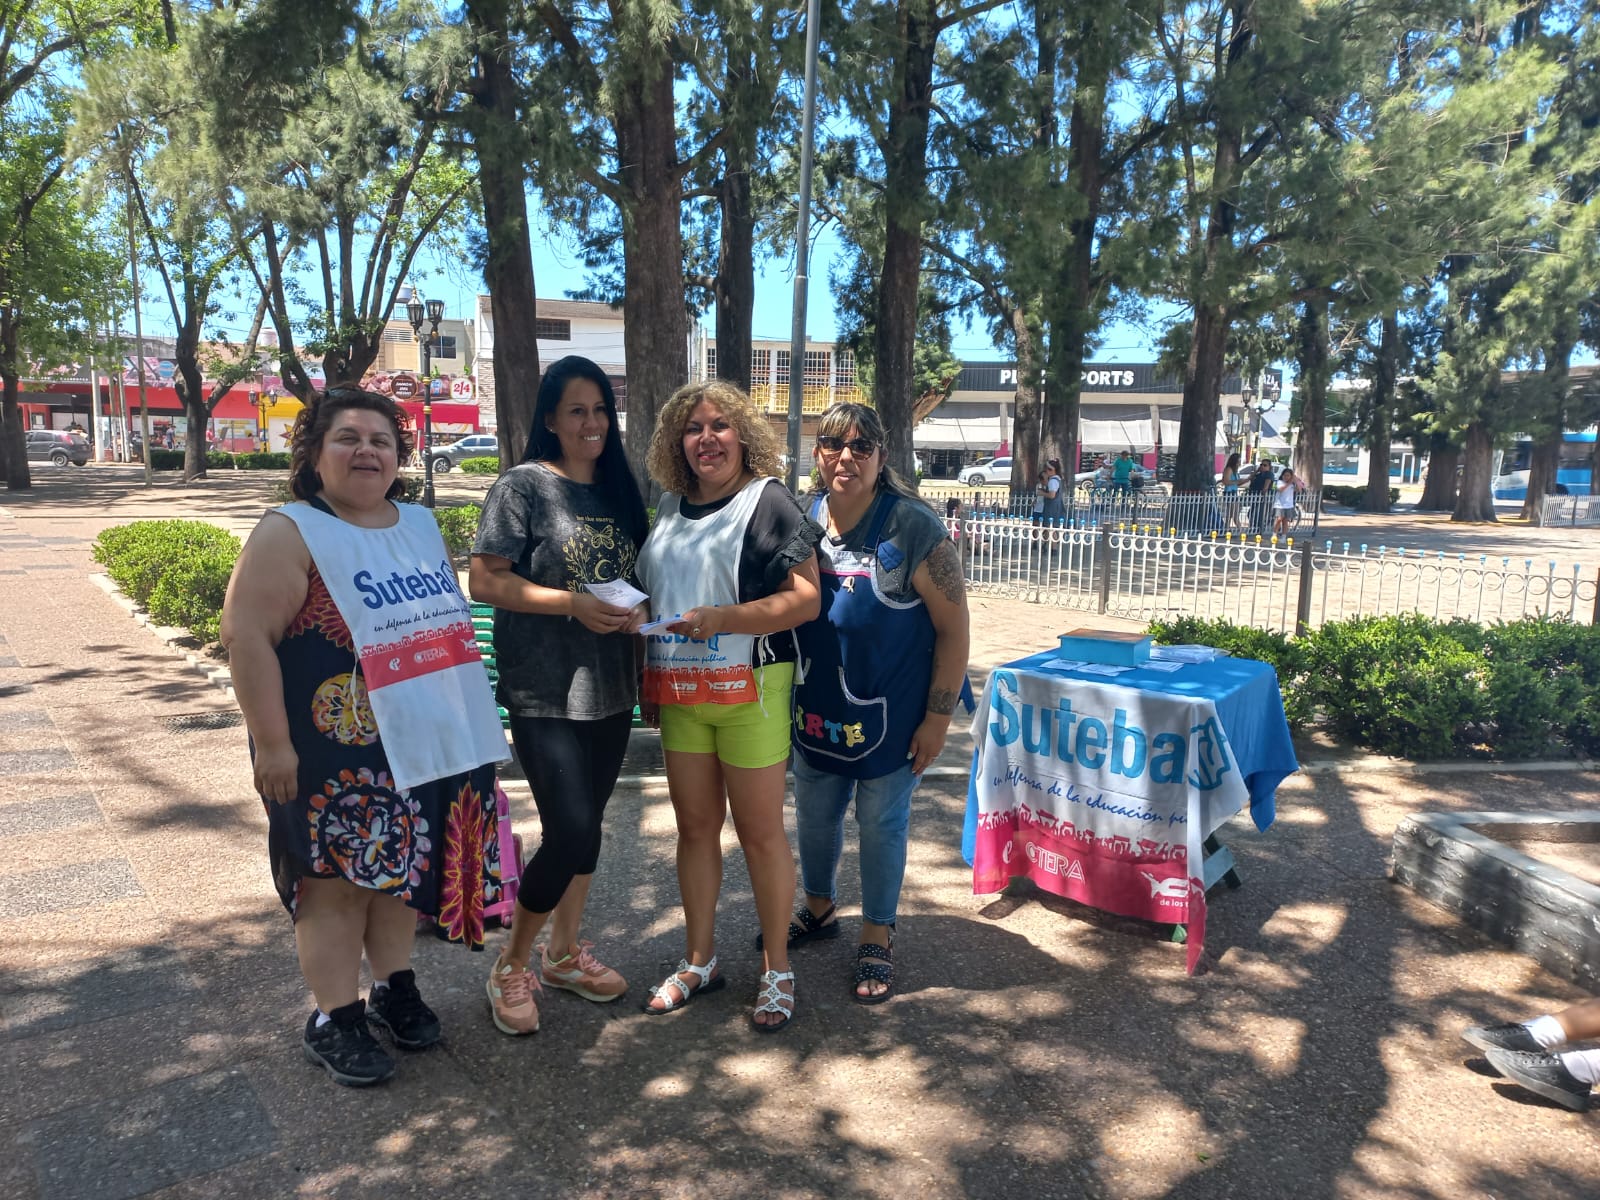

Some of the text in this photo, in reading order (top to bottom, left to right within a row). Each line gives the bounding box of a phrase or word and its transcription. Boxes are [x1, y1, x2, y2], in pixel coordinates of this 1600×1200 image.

[1081, 370, 1134, 385] PORTS
[353, 567, 455, 610] Suteba
[385, 618, 412, 631] defensa
[413, 613, 421, 623] de
[423, 611, 430, 620] la
[413, 647, 449, 663] CTERA
[989, 670, 1187, 785] Suteba
[1005, 766, 1042, 791] defensa
[1048, 780, 1062, 797] de
[1066, 785, 1081, 804] la
[1087, 796, 1163, 822] educación
[1025, 841, 1086, 883] CTERA
[1171, 899, 1184, 908] los
